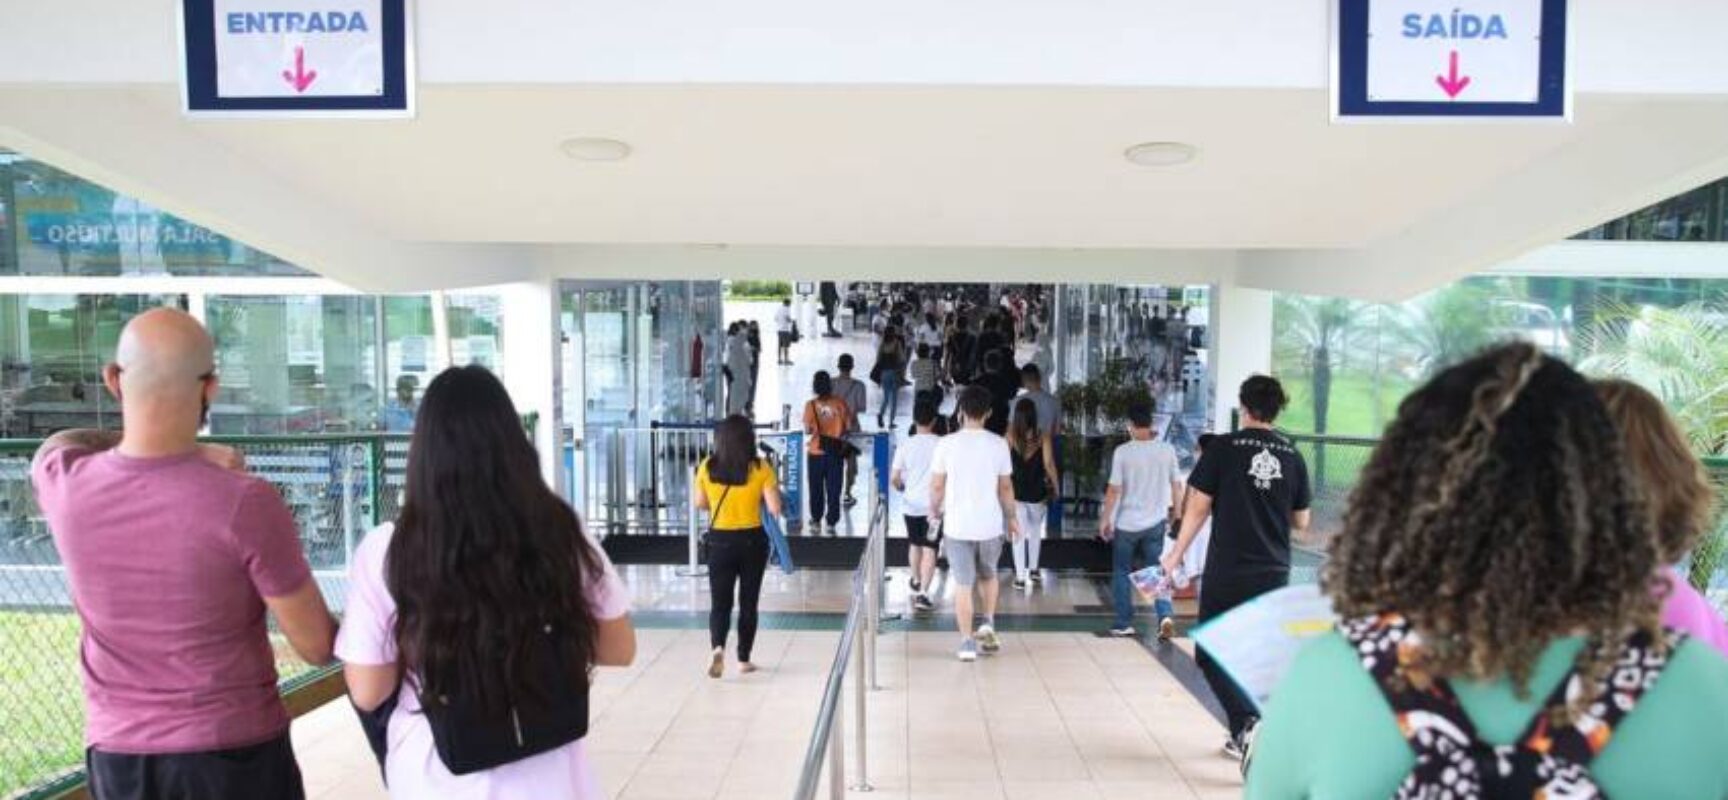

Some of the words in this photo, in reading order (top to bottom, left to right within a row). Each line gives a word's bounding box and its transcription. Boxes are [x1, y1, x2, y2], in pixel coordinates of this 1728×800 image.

[227, 11, 368, 33] ENTRADA
[1402, 8, 1508, 39] SAÍDA
[787, 439, 799, 492] ENTRADA
